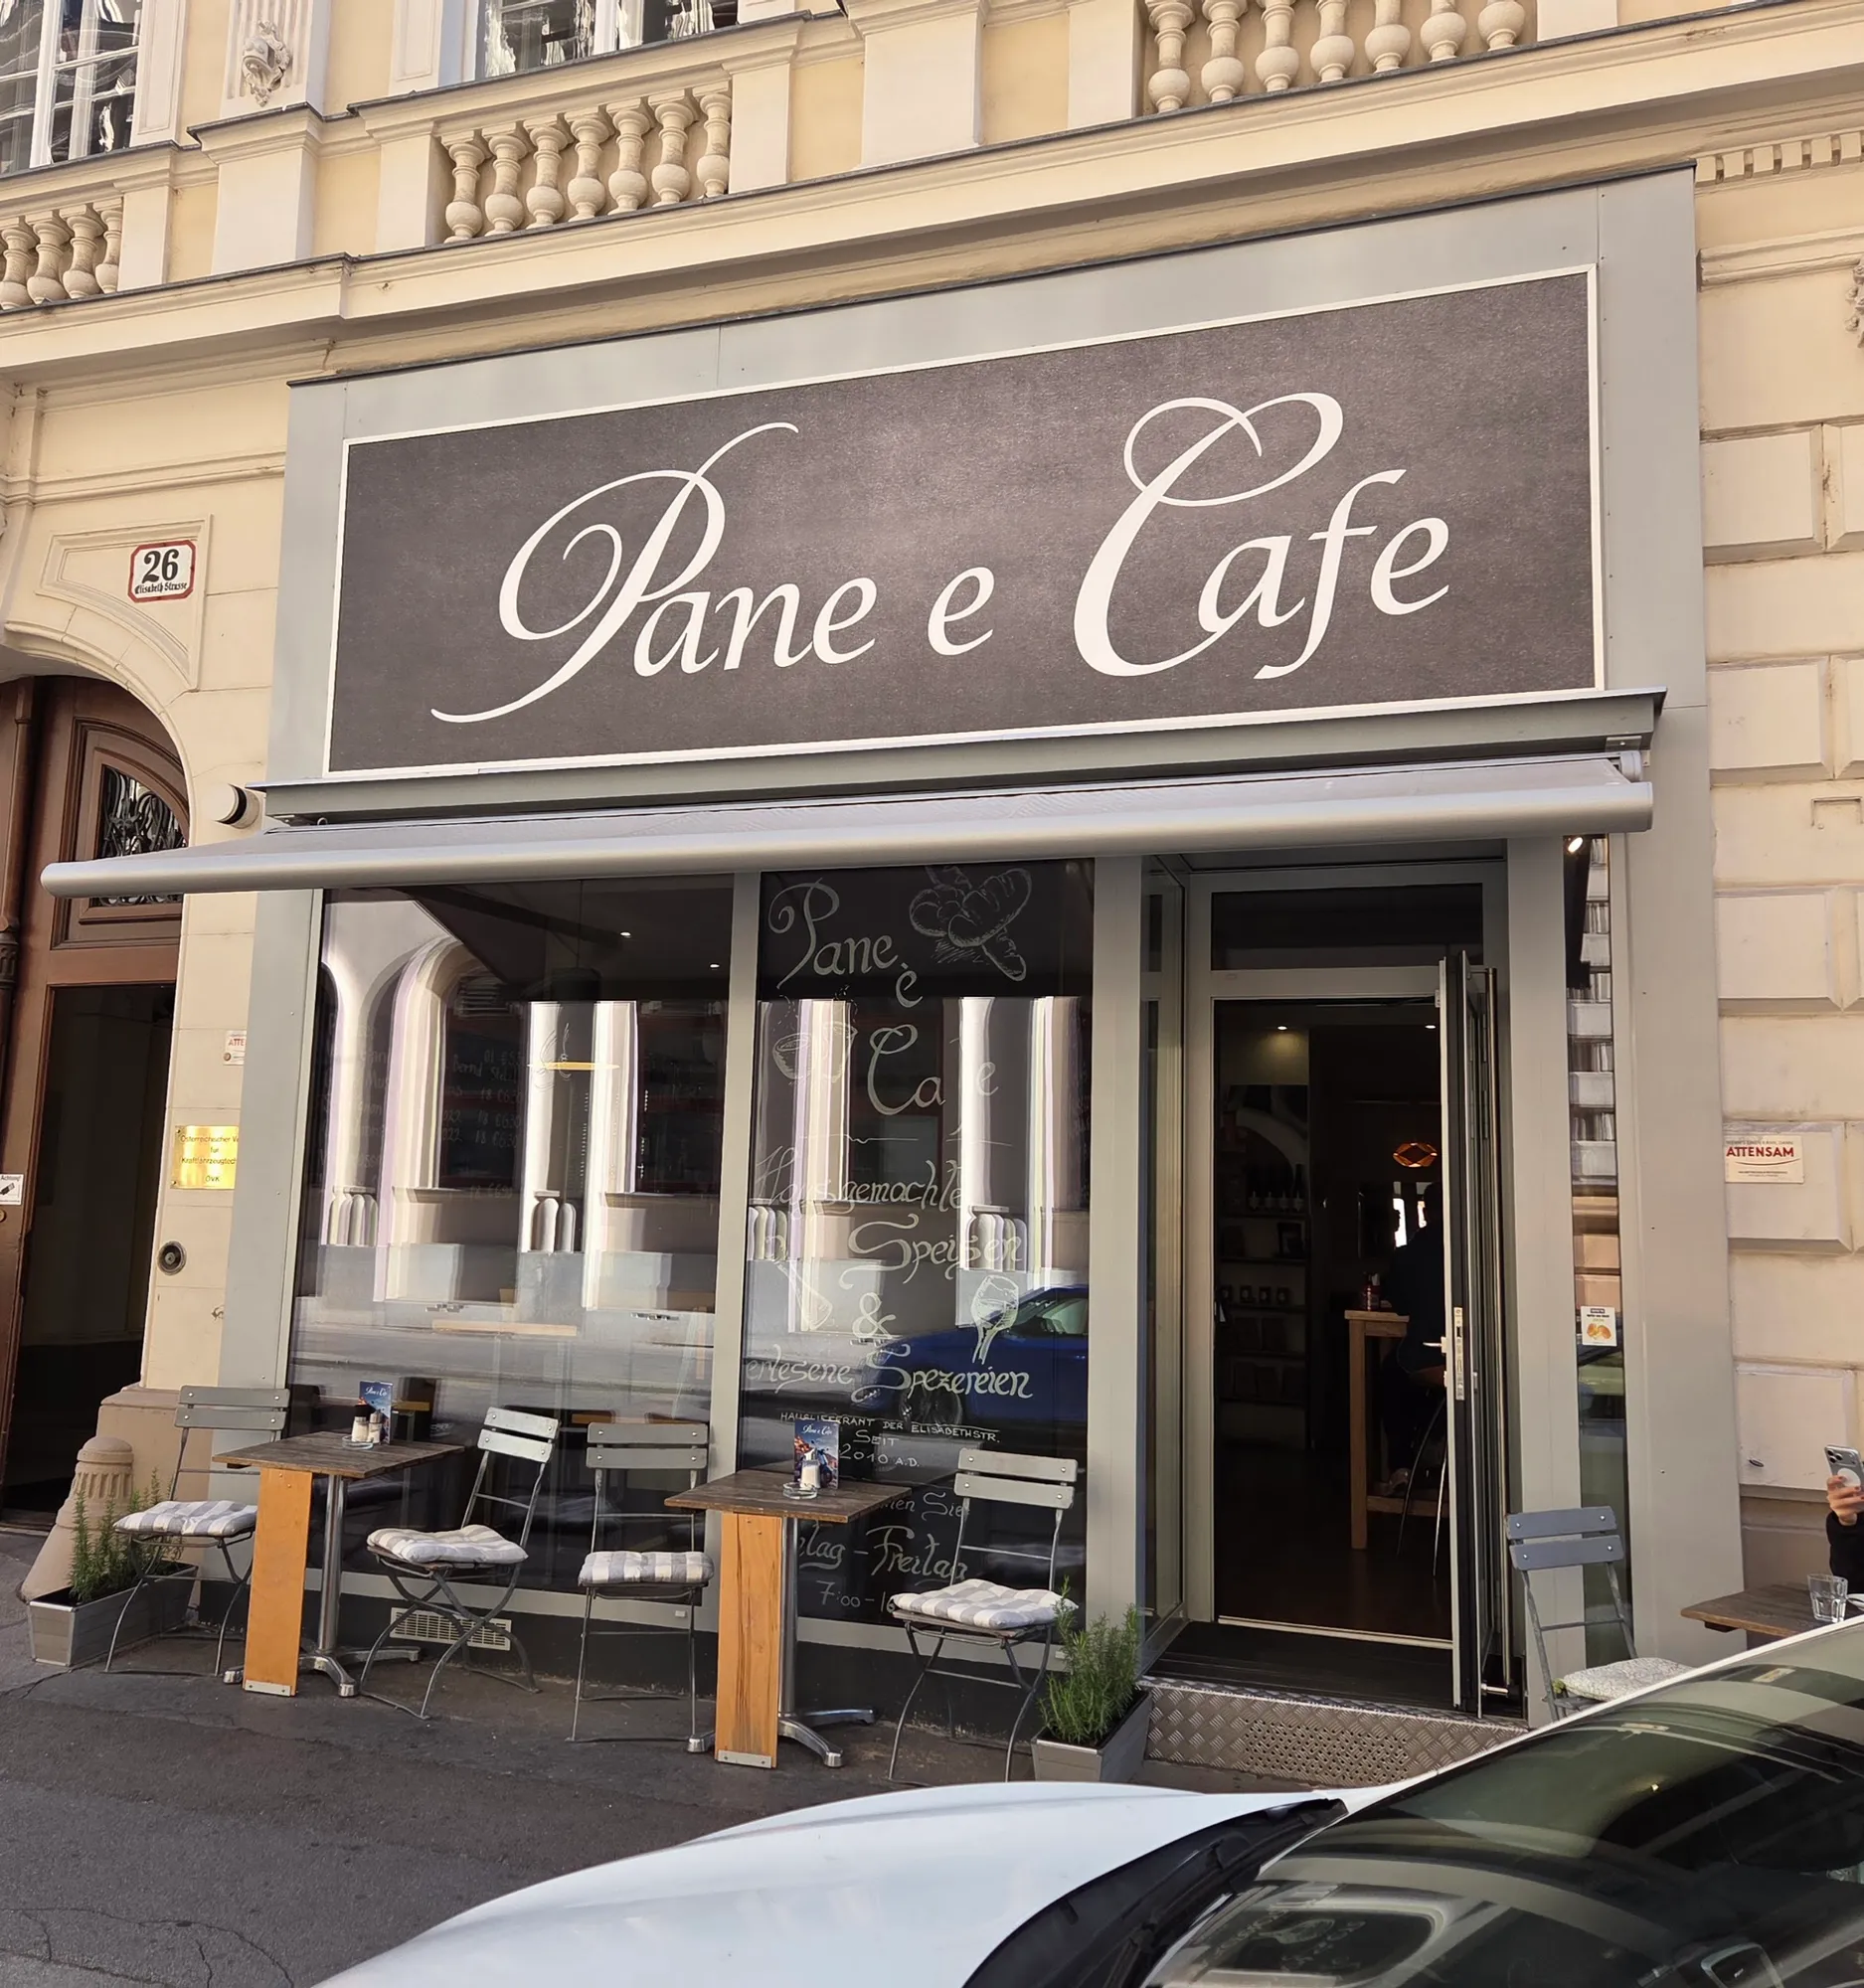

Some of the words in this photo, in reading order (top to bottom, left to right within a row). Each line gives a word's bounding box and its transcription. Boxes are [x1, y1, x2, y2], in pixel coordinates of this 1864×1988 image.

[142, 549, 180, 584] 26
[430, 421, 878, 724] Pane
[928, 566, 995, 656] e
[1073, 392, 1449, 680] Cafe
[165, 582, 187, 591] Strasse
[767, 878, 899, 989] Pane
[228, 1038, 247, 1047] ATTE
[867, 1023, 999, 1135] Cae
[1726, 1146, 1794, 1157] ATTENSAM
[850, 1291, 897, 1340] &
[851, 1343, 1034, 1404] Spezereien
[882, 1421, 904, 1431] DER
[839, 1443, 889, 1466] 2010
[895, 1456, 921, 1468] A.D.
